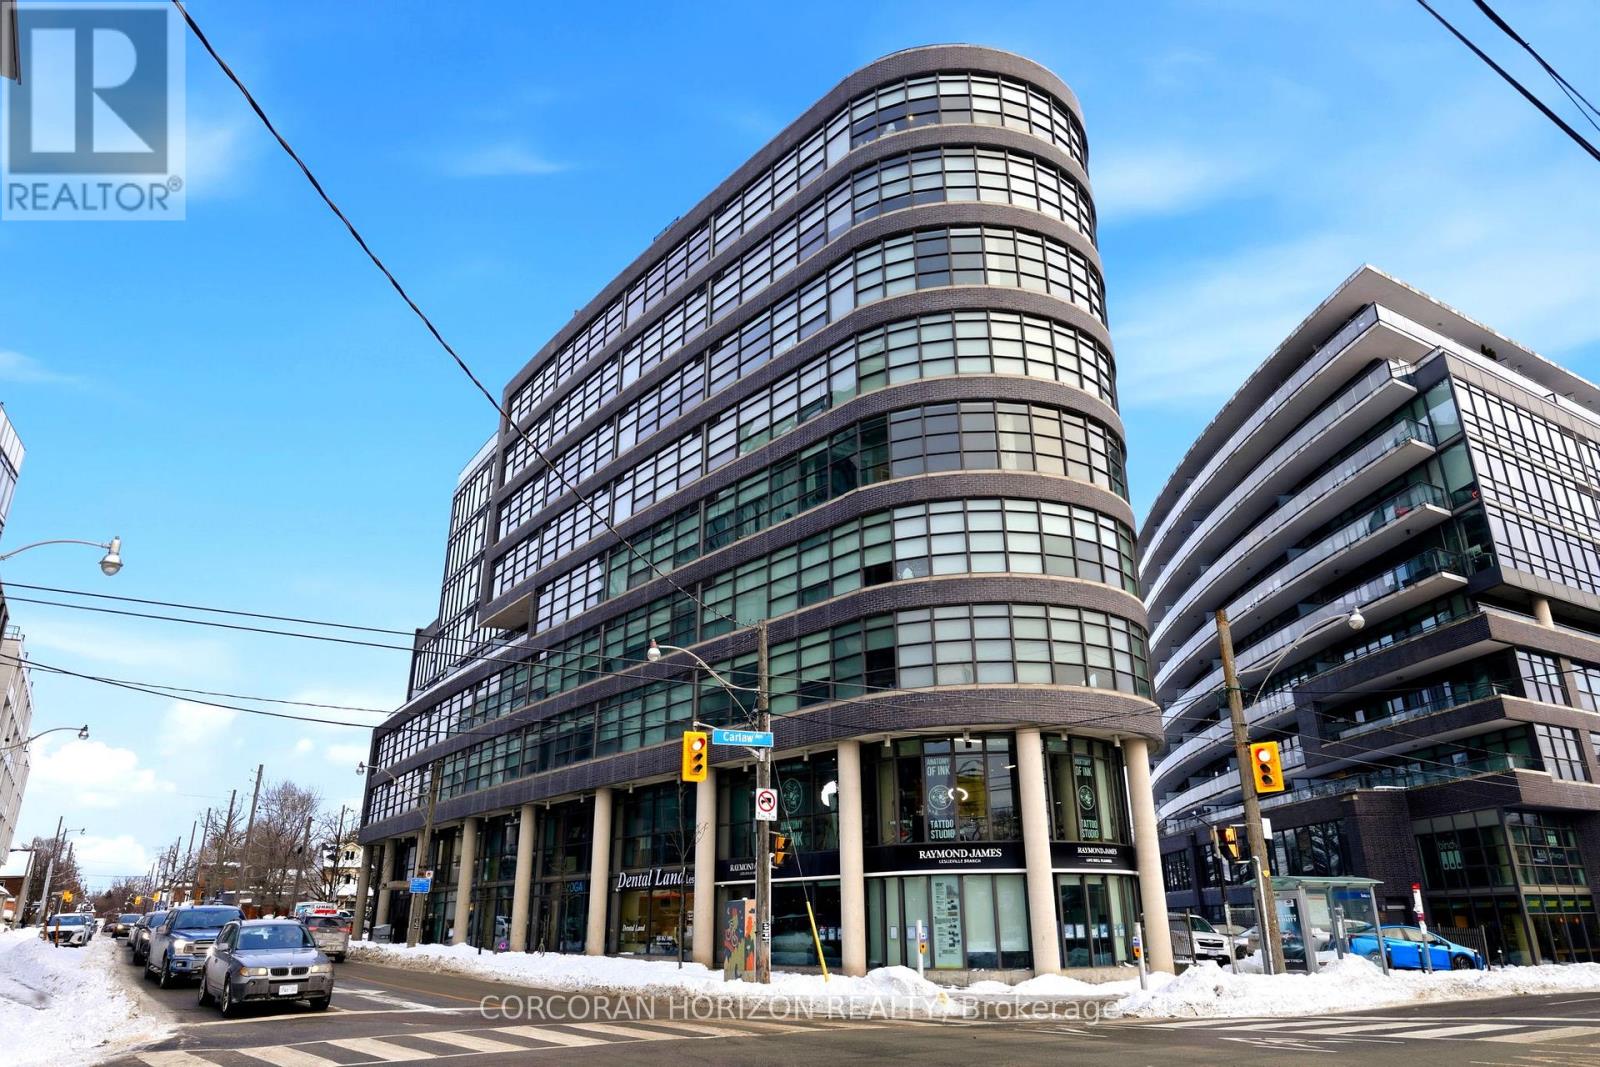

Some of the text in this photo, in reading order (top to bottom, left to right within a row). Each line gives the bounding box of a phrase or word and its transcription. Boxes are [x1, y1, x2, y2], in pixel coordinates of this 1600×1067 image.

[723, 731, 753, 743] Carlaw
[927, 765, 950, 776] OF INK
[930, 820, 954, 829] TATTOO
[930, 830, 956, 839] STUDIO
[919, 848, 1002, 859] RAYMOND JAMES
[617, 869, 653, 888] Dental
[655, 866, 686, 886] Land
